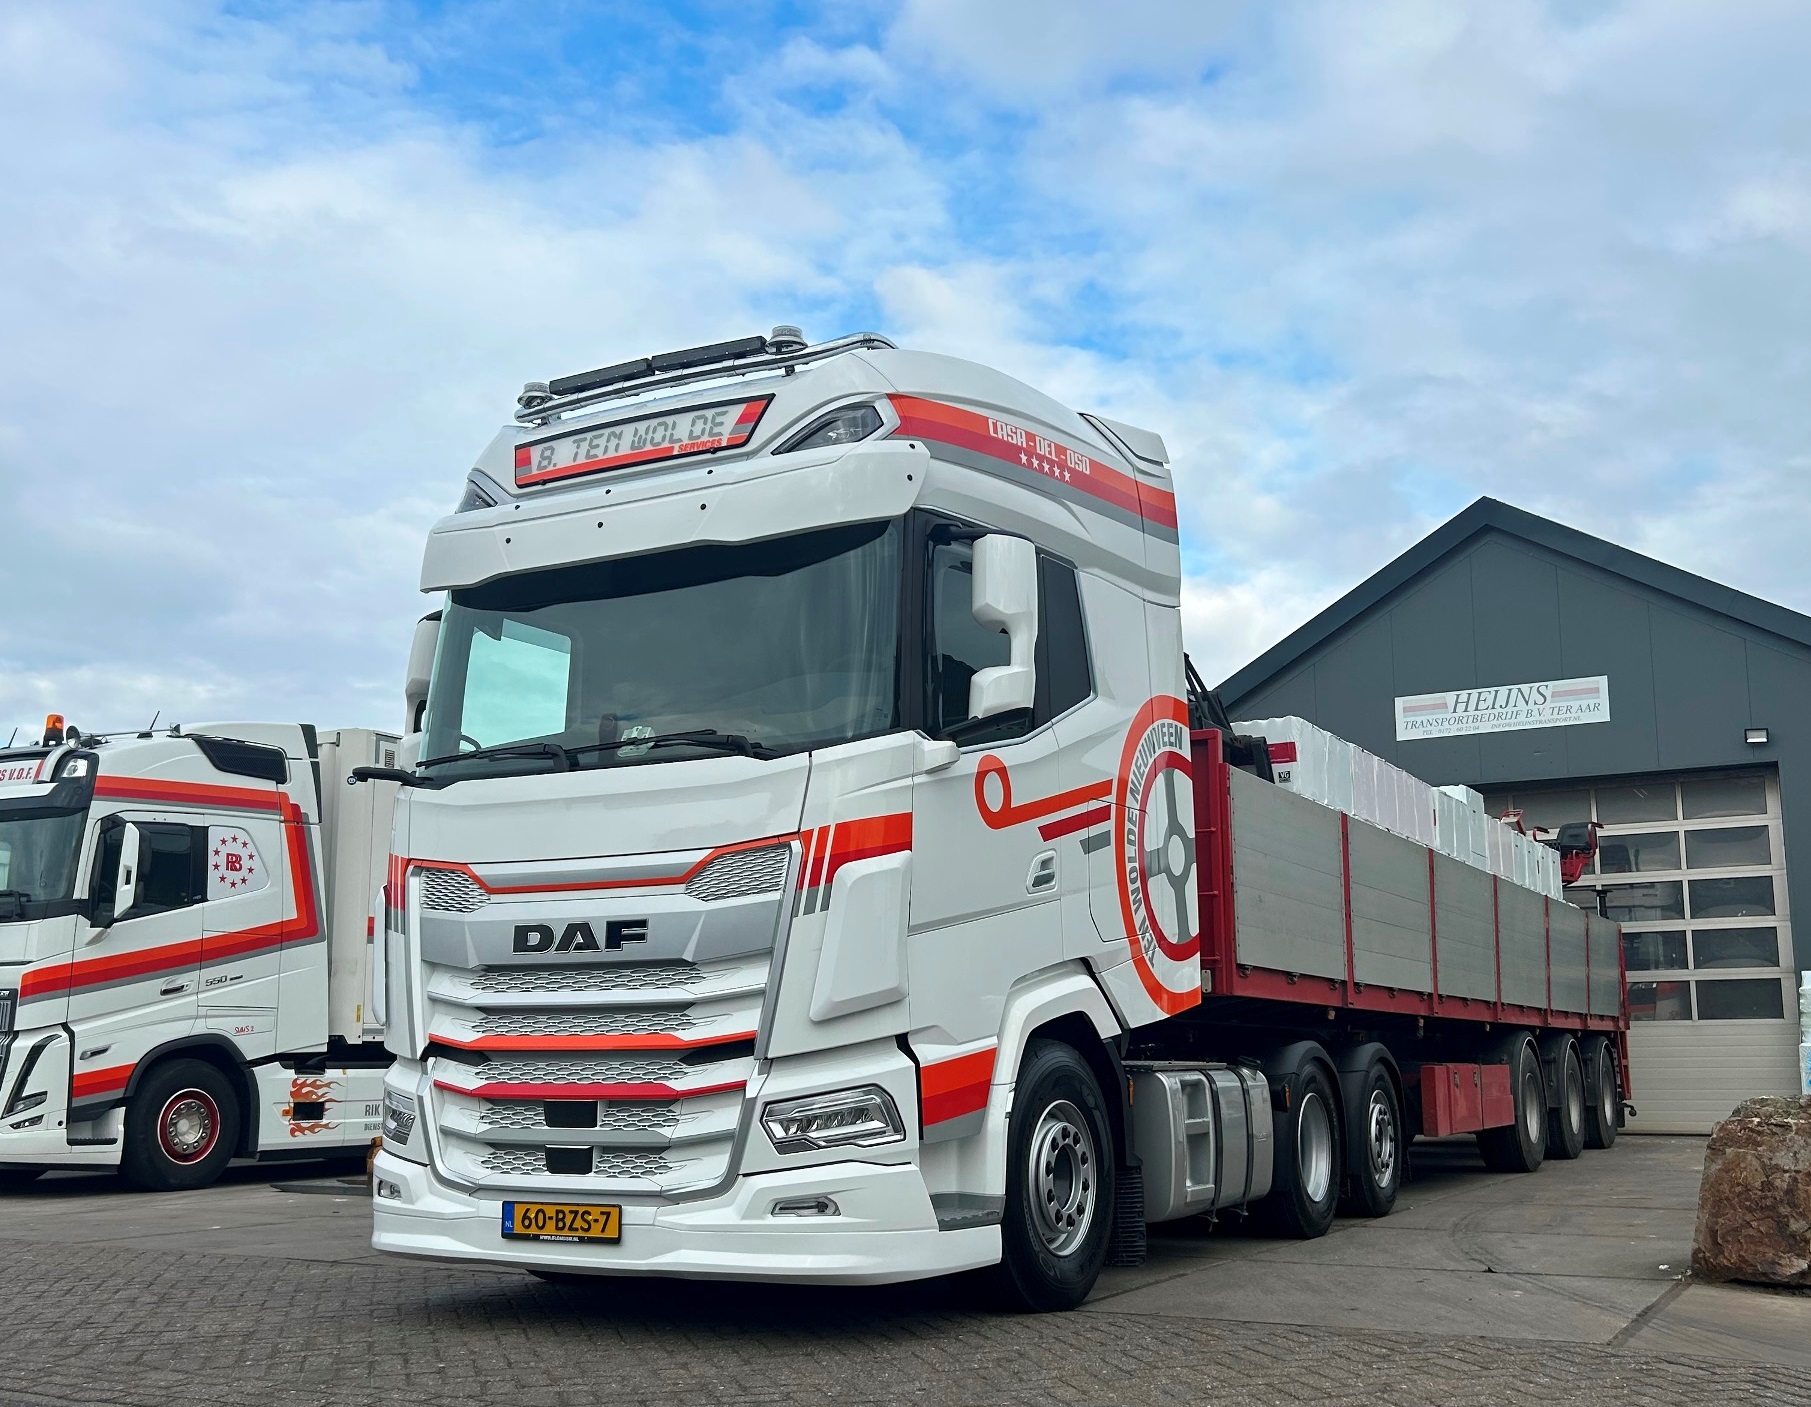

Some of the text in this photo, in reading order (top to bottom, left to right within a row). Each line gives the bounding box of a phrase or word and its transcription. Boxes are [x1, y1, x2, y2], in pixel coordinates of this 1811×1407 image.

[572, 429, 624, 462] TEN
[629, 410, 729, 451] WOLDE
[677, 438, 723, 454] SERVICES
[1451, 684, 1549, 714] HEIJNS
[1403, 702, 1601, 730] TRANSPORTBEDRIJF B.V. TER AAR
[8, 767, 33, 781] V.O.F.
[1129, 722, 1183, 806] NIEUWVEEN
[1126, 806, 1143, 915] WOLDE
[512, 918, 649, 955] DAF
[205, 975, 228, 987] 550
[364, 1103, 381, 1117] RIK
[505, 1220, 514, 1228] NL
[521, 1207, 612, 1234] 60-BZS-7
